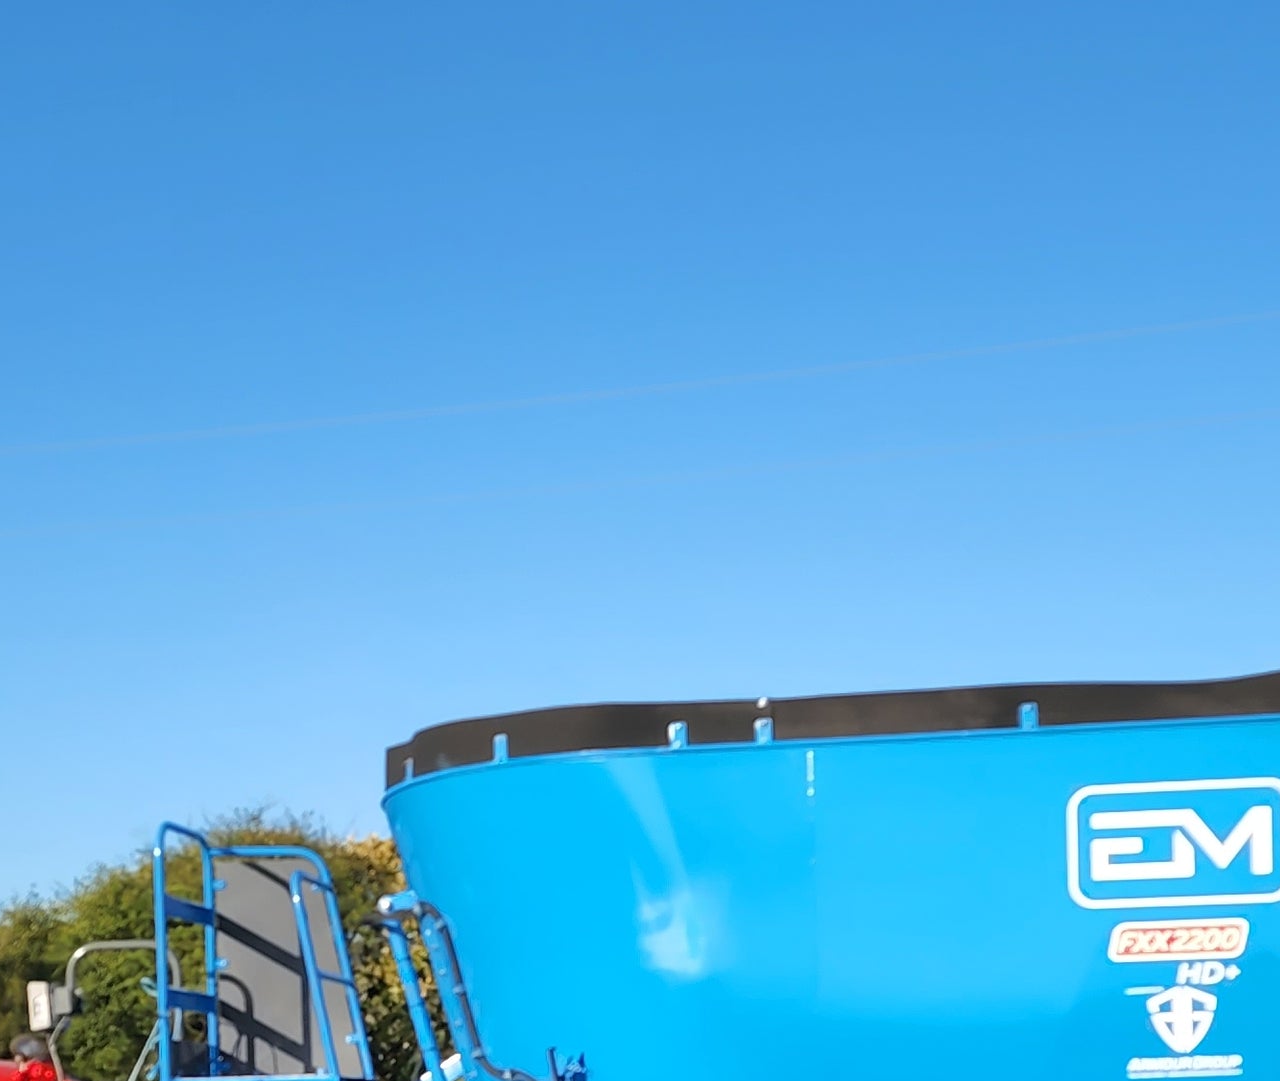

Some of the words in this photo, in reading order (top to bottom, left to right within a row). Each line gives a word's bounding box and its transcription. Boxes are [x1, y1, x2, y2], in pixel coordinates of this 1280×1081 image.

[1089, 805, 1273, 881] EM
[1120, 928, 1240, 953] FXX2200
[1176, 961, 1242, 985] HD+
